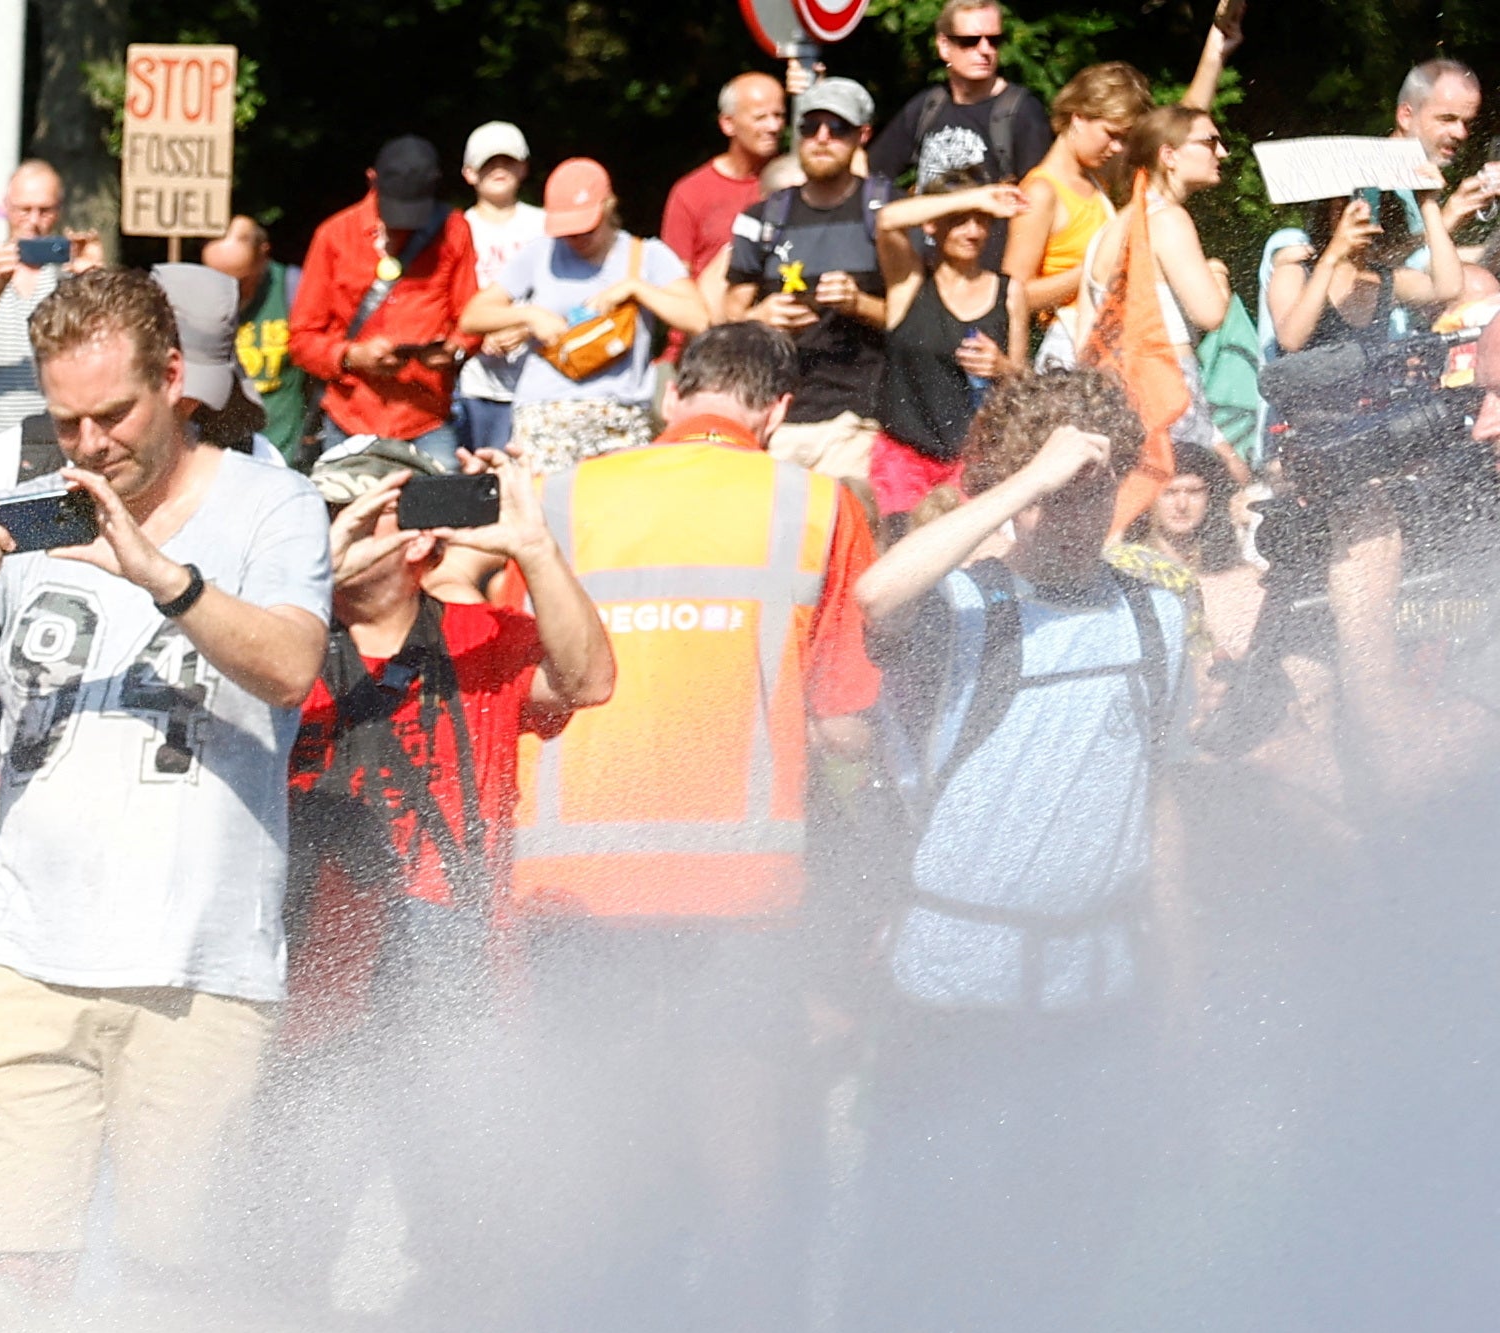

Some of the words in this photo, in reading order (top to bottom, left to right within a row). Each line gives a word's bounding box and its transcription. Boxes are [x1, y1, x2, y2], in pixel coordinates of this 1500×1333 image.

[128, 56, 231, 124] STOP
[129, 132, 228, 179] FOSSIL
[132, 186, 224, 230] FUEL
